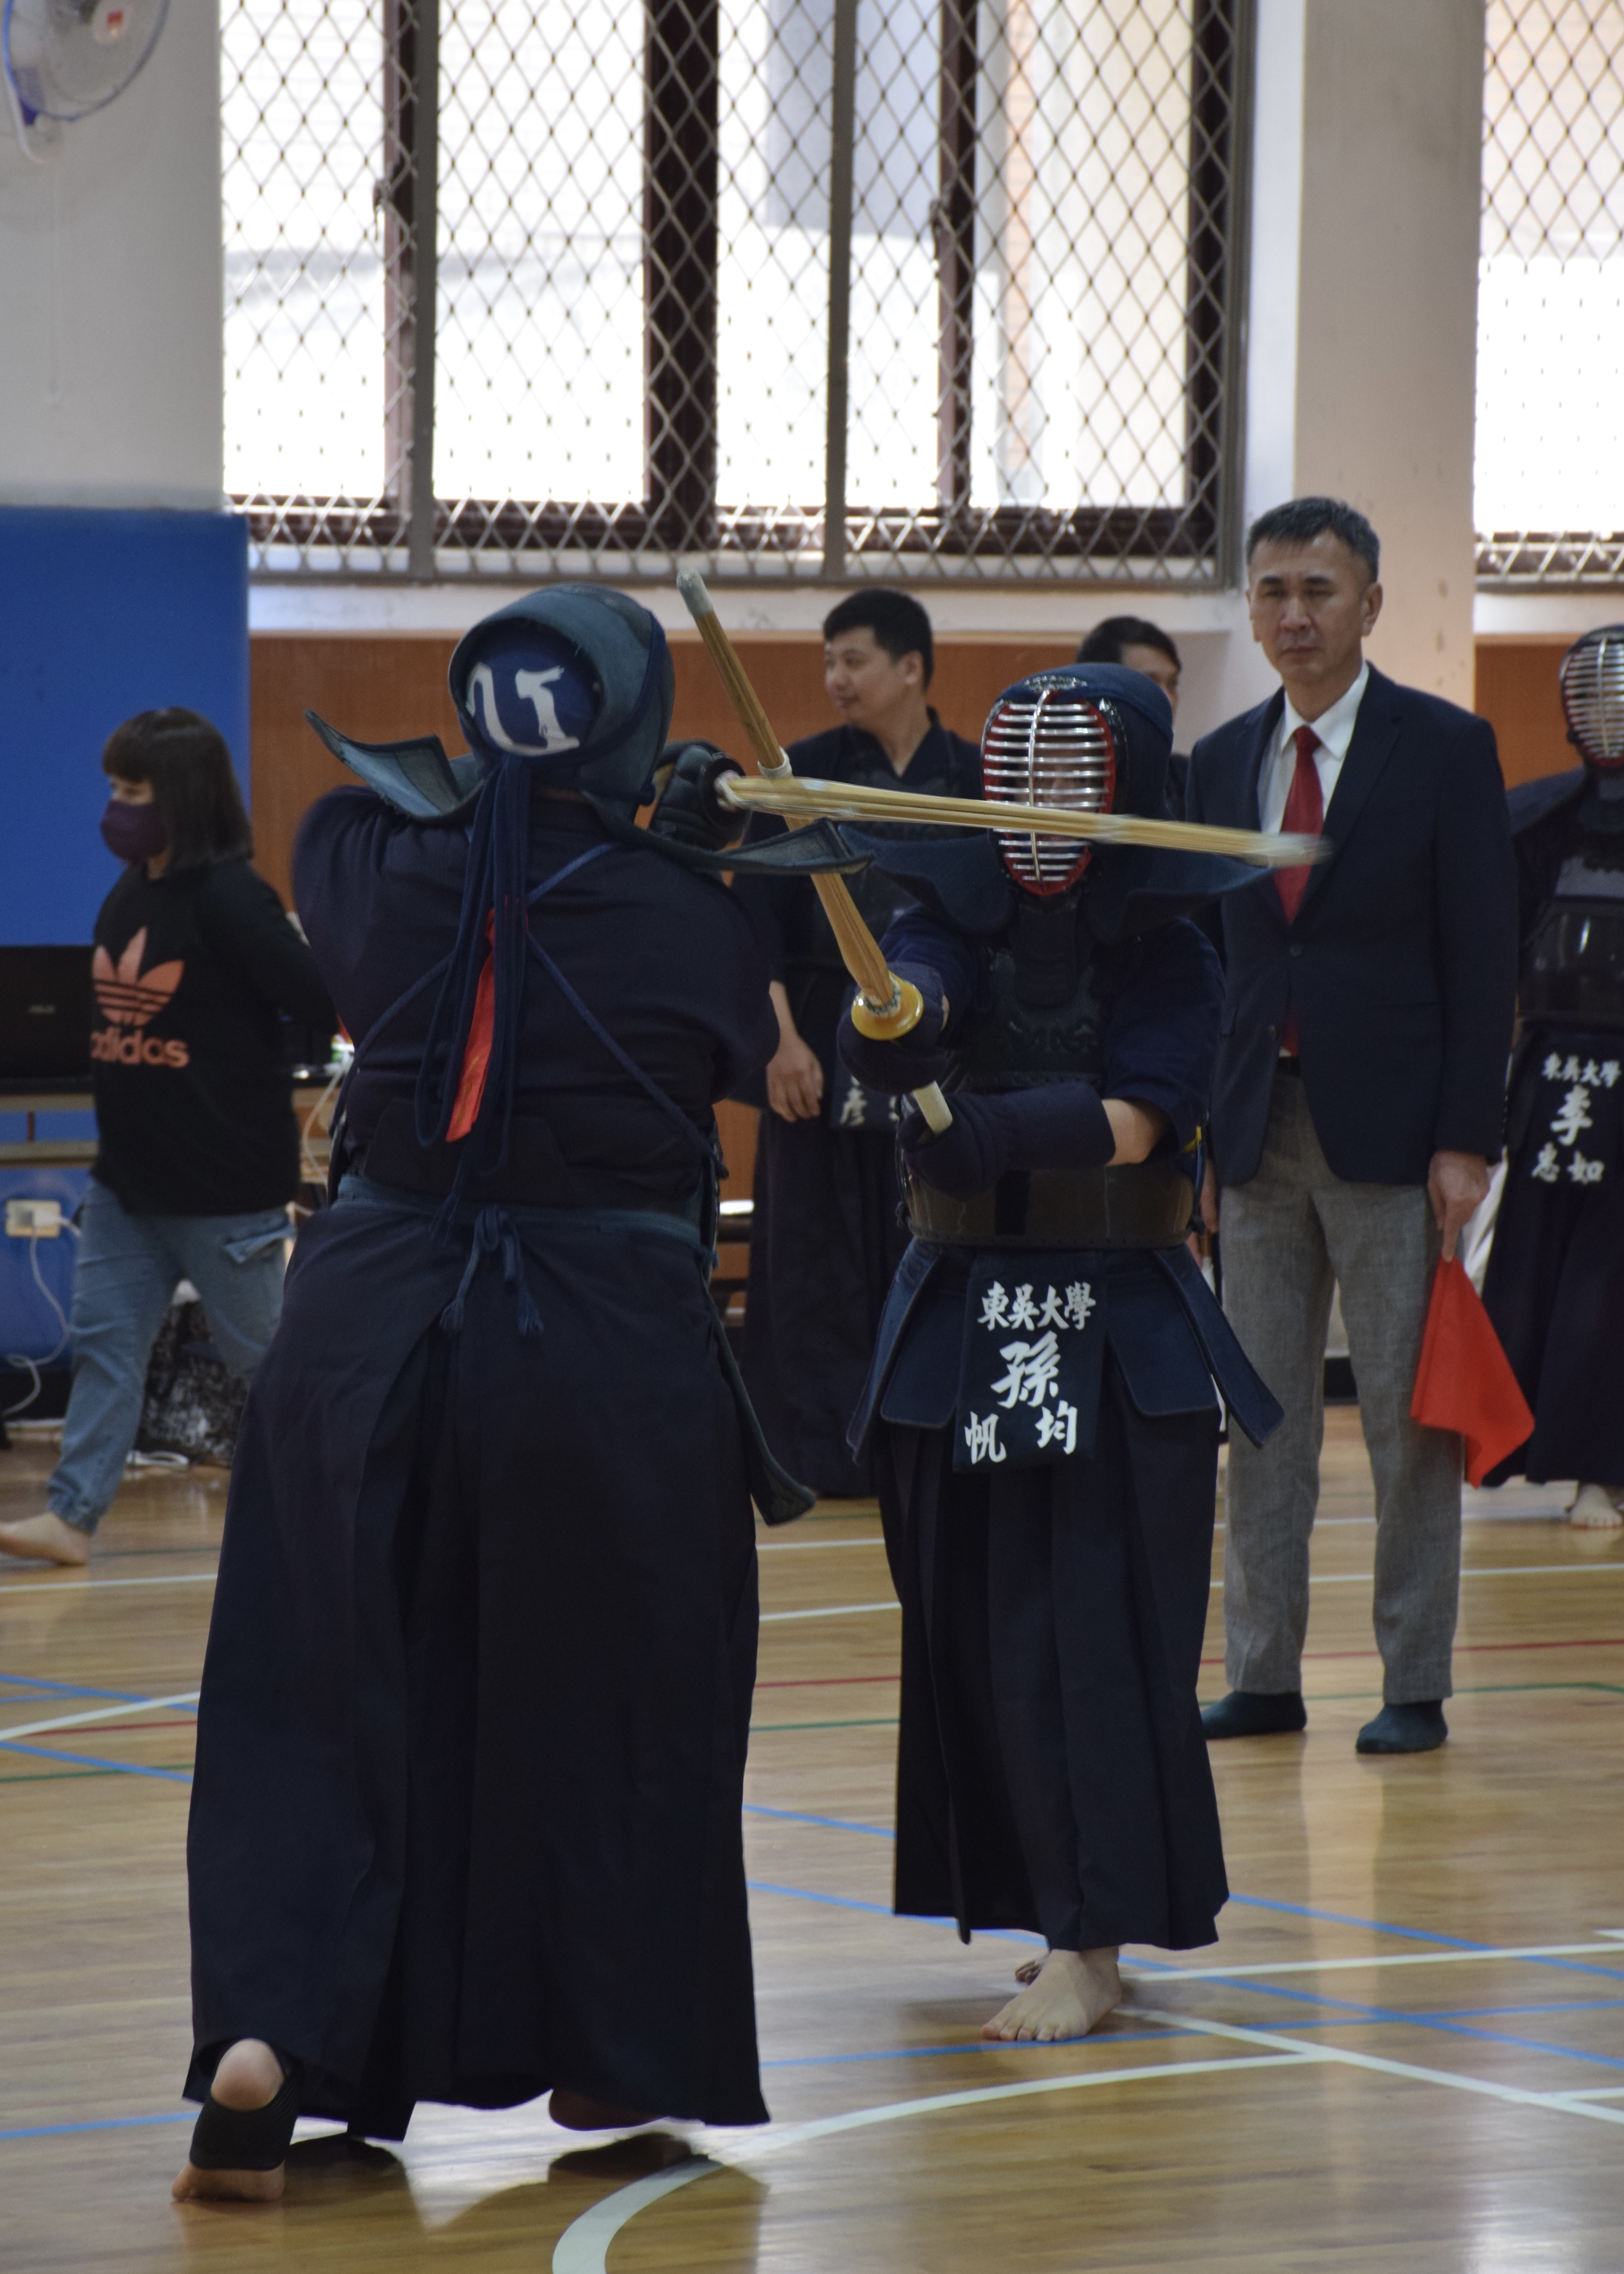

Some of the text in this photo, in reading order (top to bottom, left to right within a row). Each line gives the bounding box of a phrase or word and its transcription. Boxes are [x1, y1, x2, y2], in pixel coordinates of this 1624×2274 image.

[978, 1280, 1096, 1331] 東吳大學
[990, 1330, 1061, 1409] 孫
[964, 1399, 1078, 1465] 帆 均
